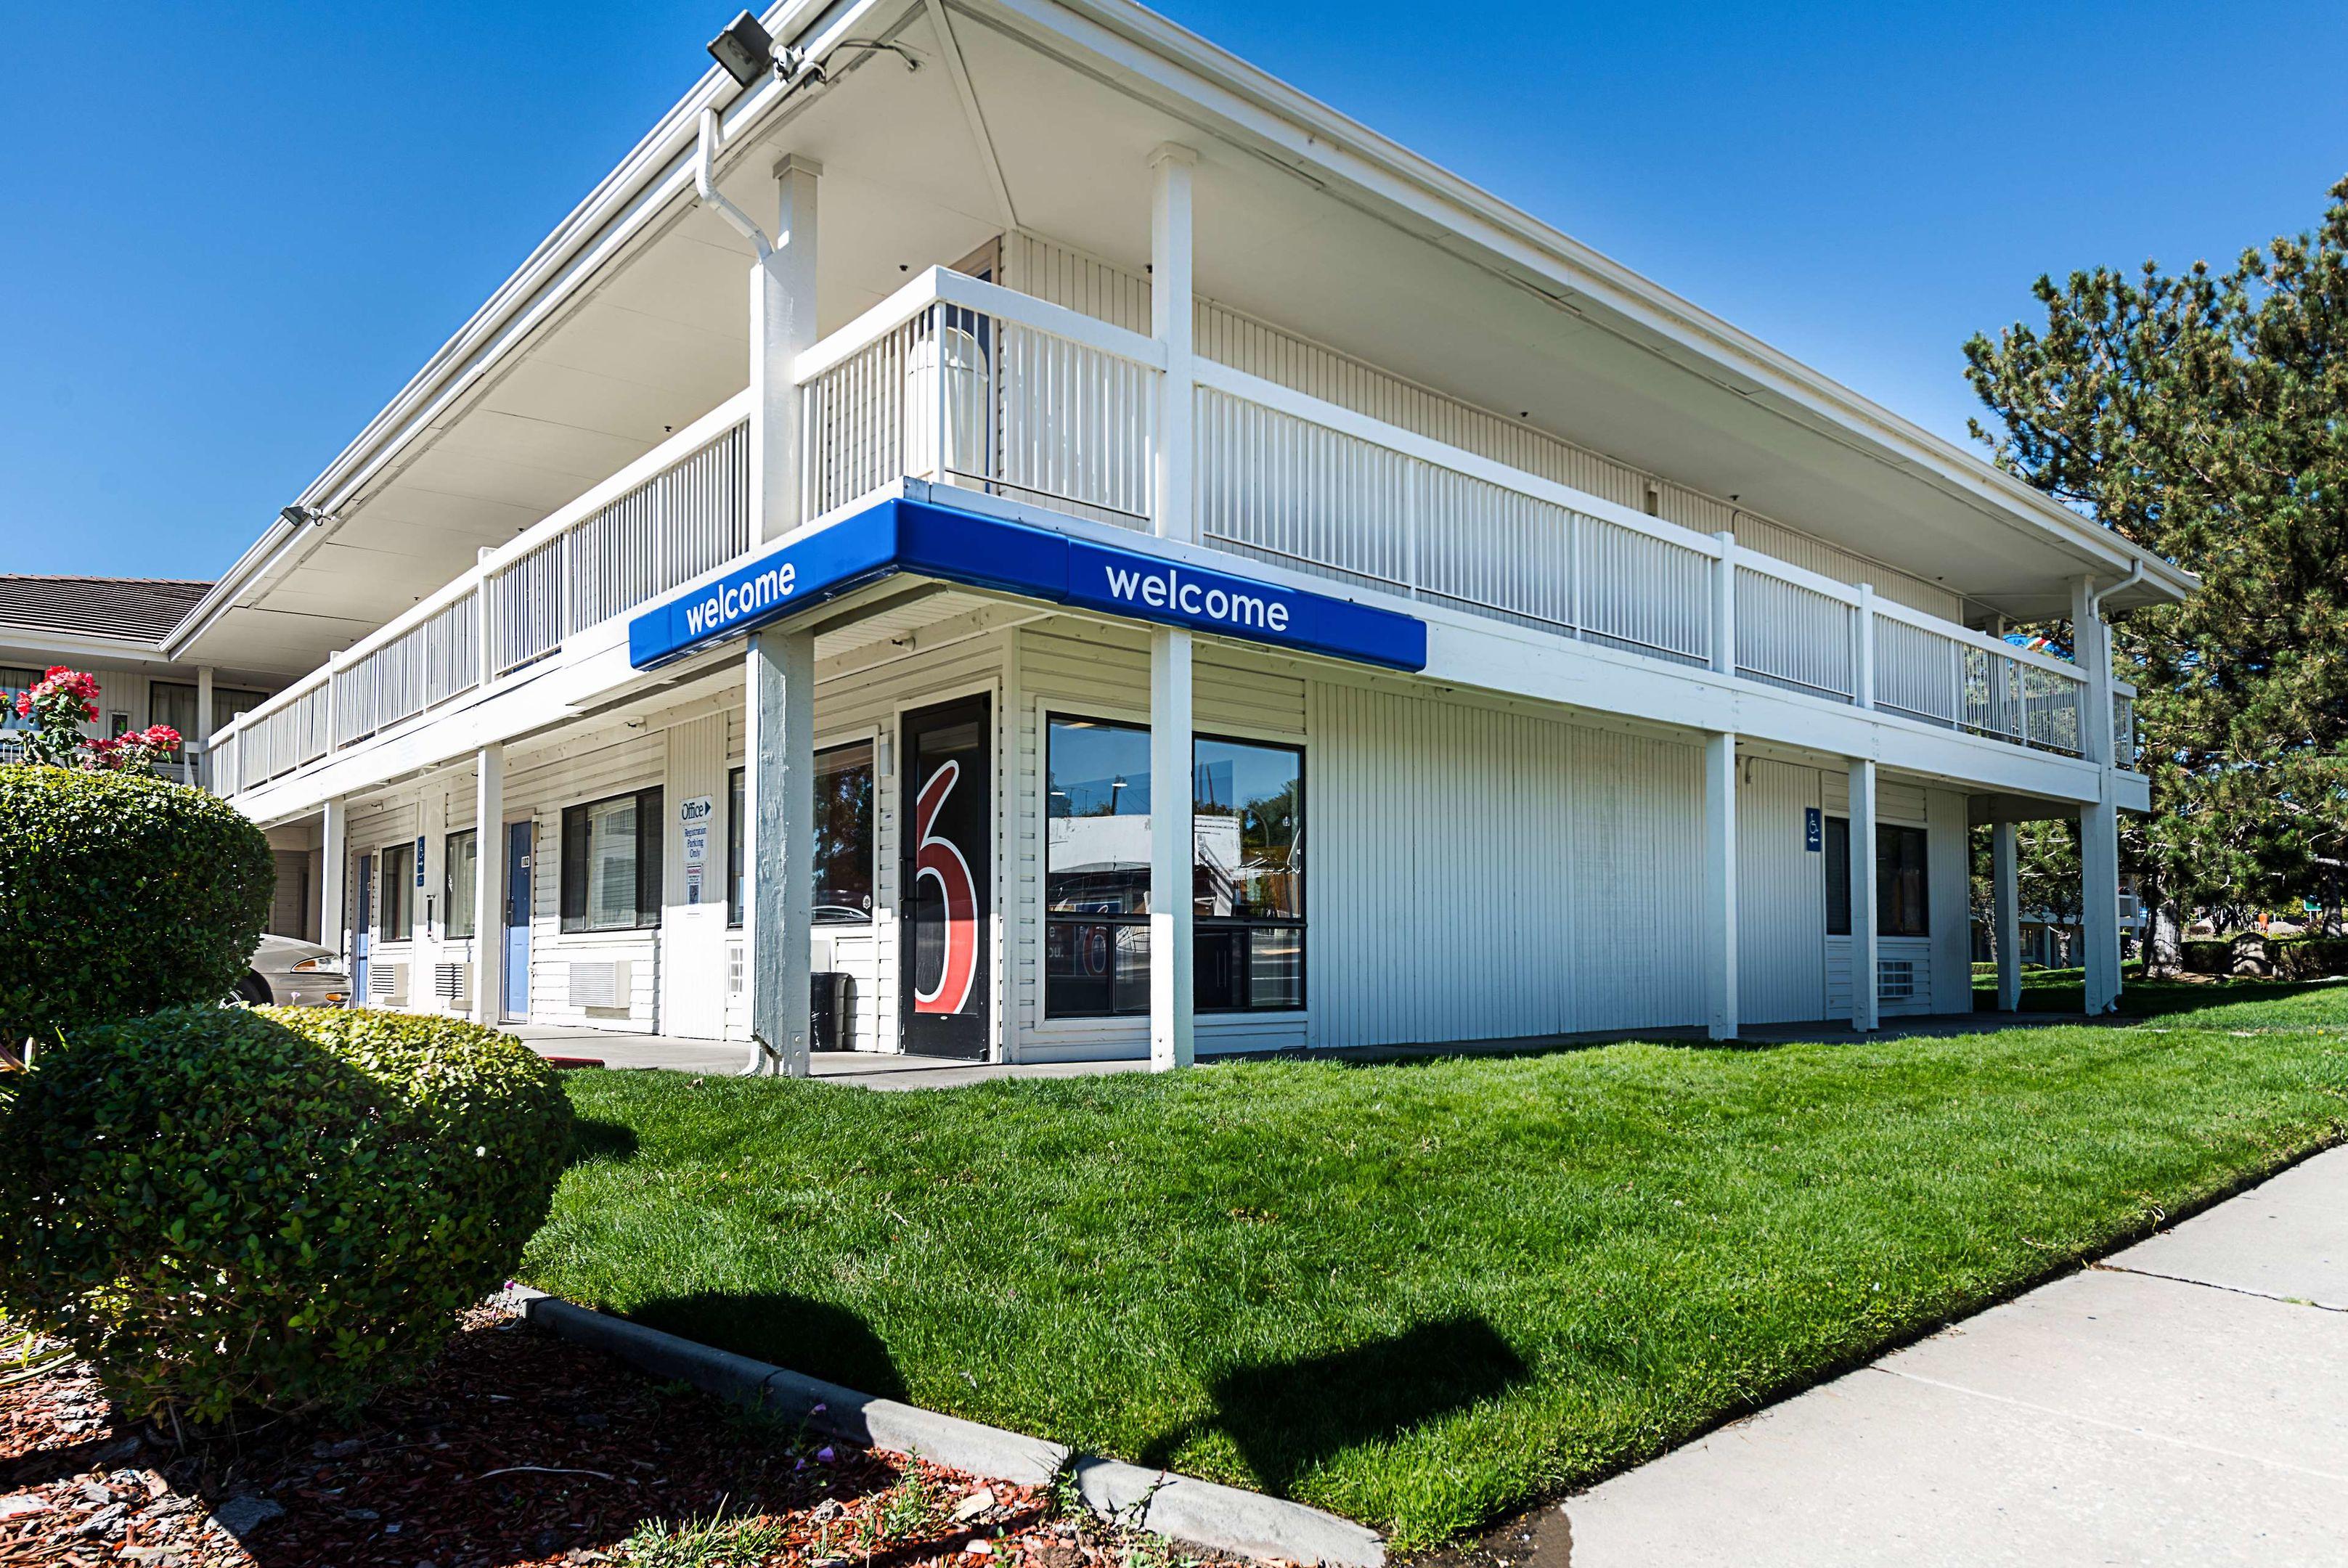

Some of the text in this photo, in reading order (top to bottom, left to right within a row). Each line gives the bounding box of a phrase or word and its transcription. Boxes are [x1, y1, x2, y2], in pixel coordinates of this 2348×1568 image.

[686, 563, 796, 636] welcome
[1105, 566, 1289, 632] welcome
[682, 801, 704, 820] Office
[685, 828, 707, 838] Registration
[687, 838, 704, 848] Parking
[690, 849, 701, 858] Only
[916, 759, 978, 1015] 6
